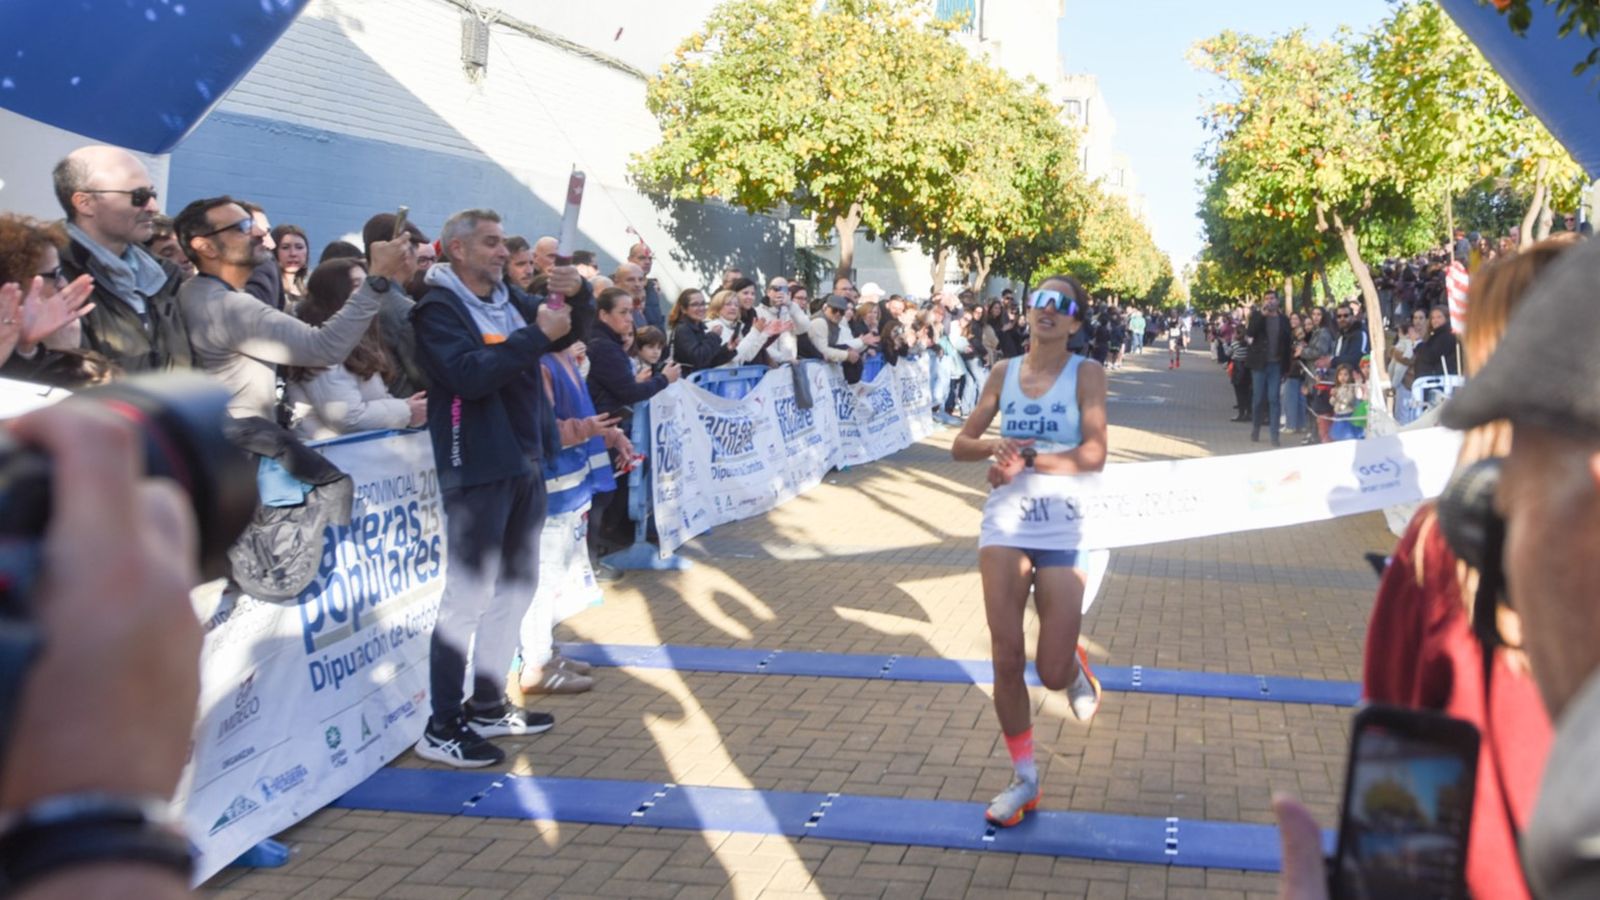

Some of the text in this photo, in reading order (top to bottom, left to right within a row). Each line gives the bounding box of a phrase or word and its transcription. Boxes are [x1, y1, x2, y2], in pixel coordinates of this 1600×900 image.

[698, 413, 754, 437] arreras
[1006, 415, 1059, 436] nerja
[355, 468, 437, 506] PROVINCIAL 20
[420, 501, 439, 535] 25
[1019, 494, 1050, 522] SAN
[319, 500, 423, 578] arreras
[298, 535, 442, 655] populares
[308, 628, 389, 692] Dipuación
[389, 621, 404, 649] de
